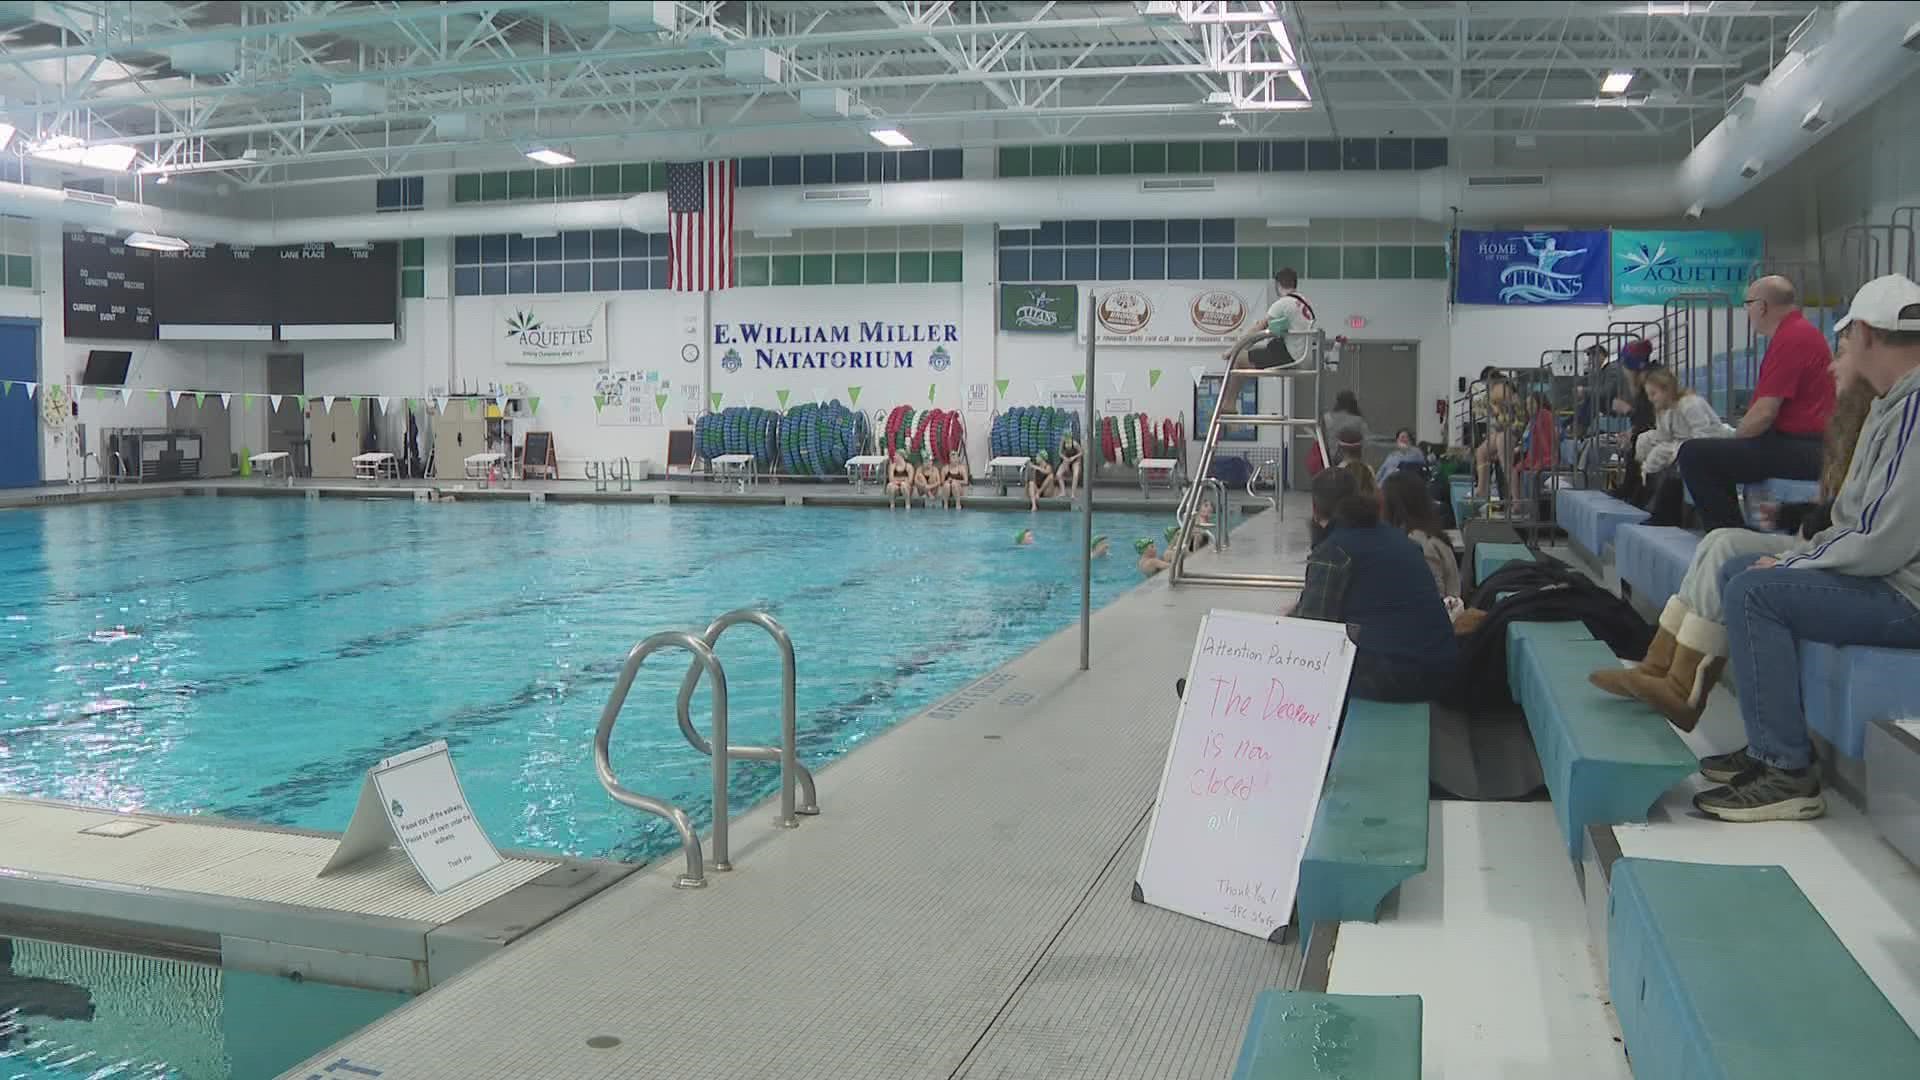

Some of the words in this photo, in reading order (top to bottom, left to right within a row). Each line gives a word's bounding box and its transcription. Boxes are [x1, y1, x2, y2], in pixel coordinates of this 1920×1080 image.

[280, 250, 300, 260] LANE
[302, 249, 326, 260] PLACE
[353, 250, 369, 259] TIME
[1478, 243, 1518, 255] HOME
[1505, 269, 1584, 298] TITANS
[72, 303, 97, 312] CURRENT
[100, 313, 117, 322] EVENT
[519, 328, 593, 349] AQUETTES
[859, 321, 959, 343] MILLER
[756, 349, 914, 370] NATATORIUM
[1203, 637, 1263, 662] Attention
[1267, 645, 1331, 674] Patrons!
[1210, 675, 1252, 719] The
[1203, 730, 1225, 760] is
[401, 820, 418, 831] Please
[418, 817, 429, 826] stay
[447, 858, 463, 869] Thank
[1216, 879, 1250, 898] Thank
